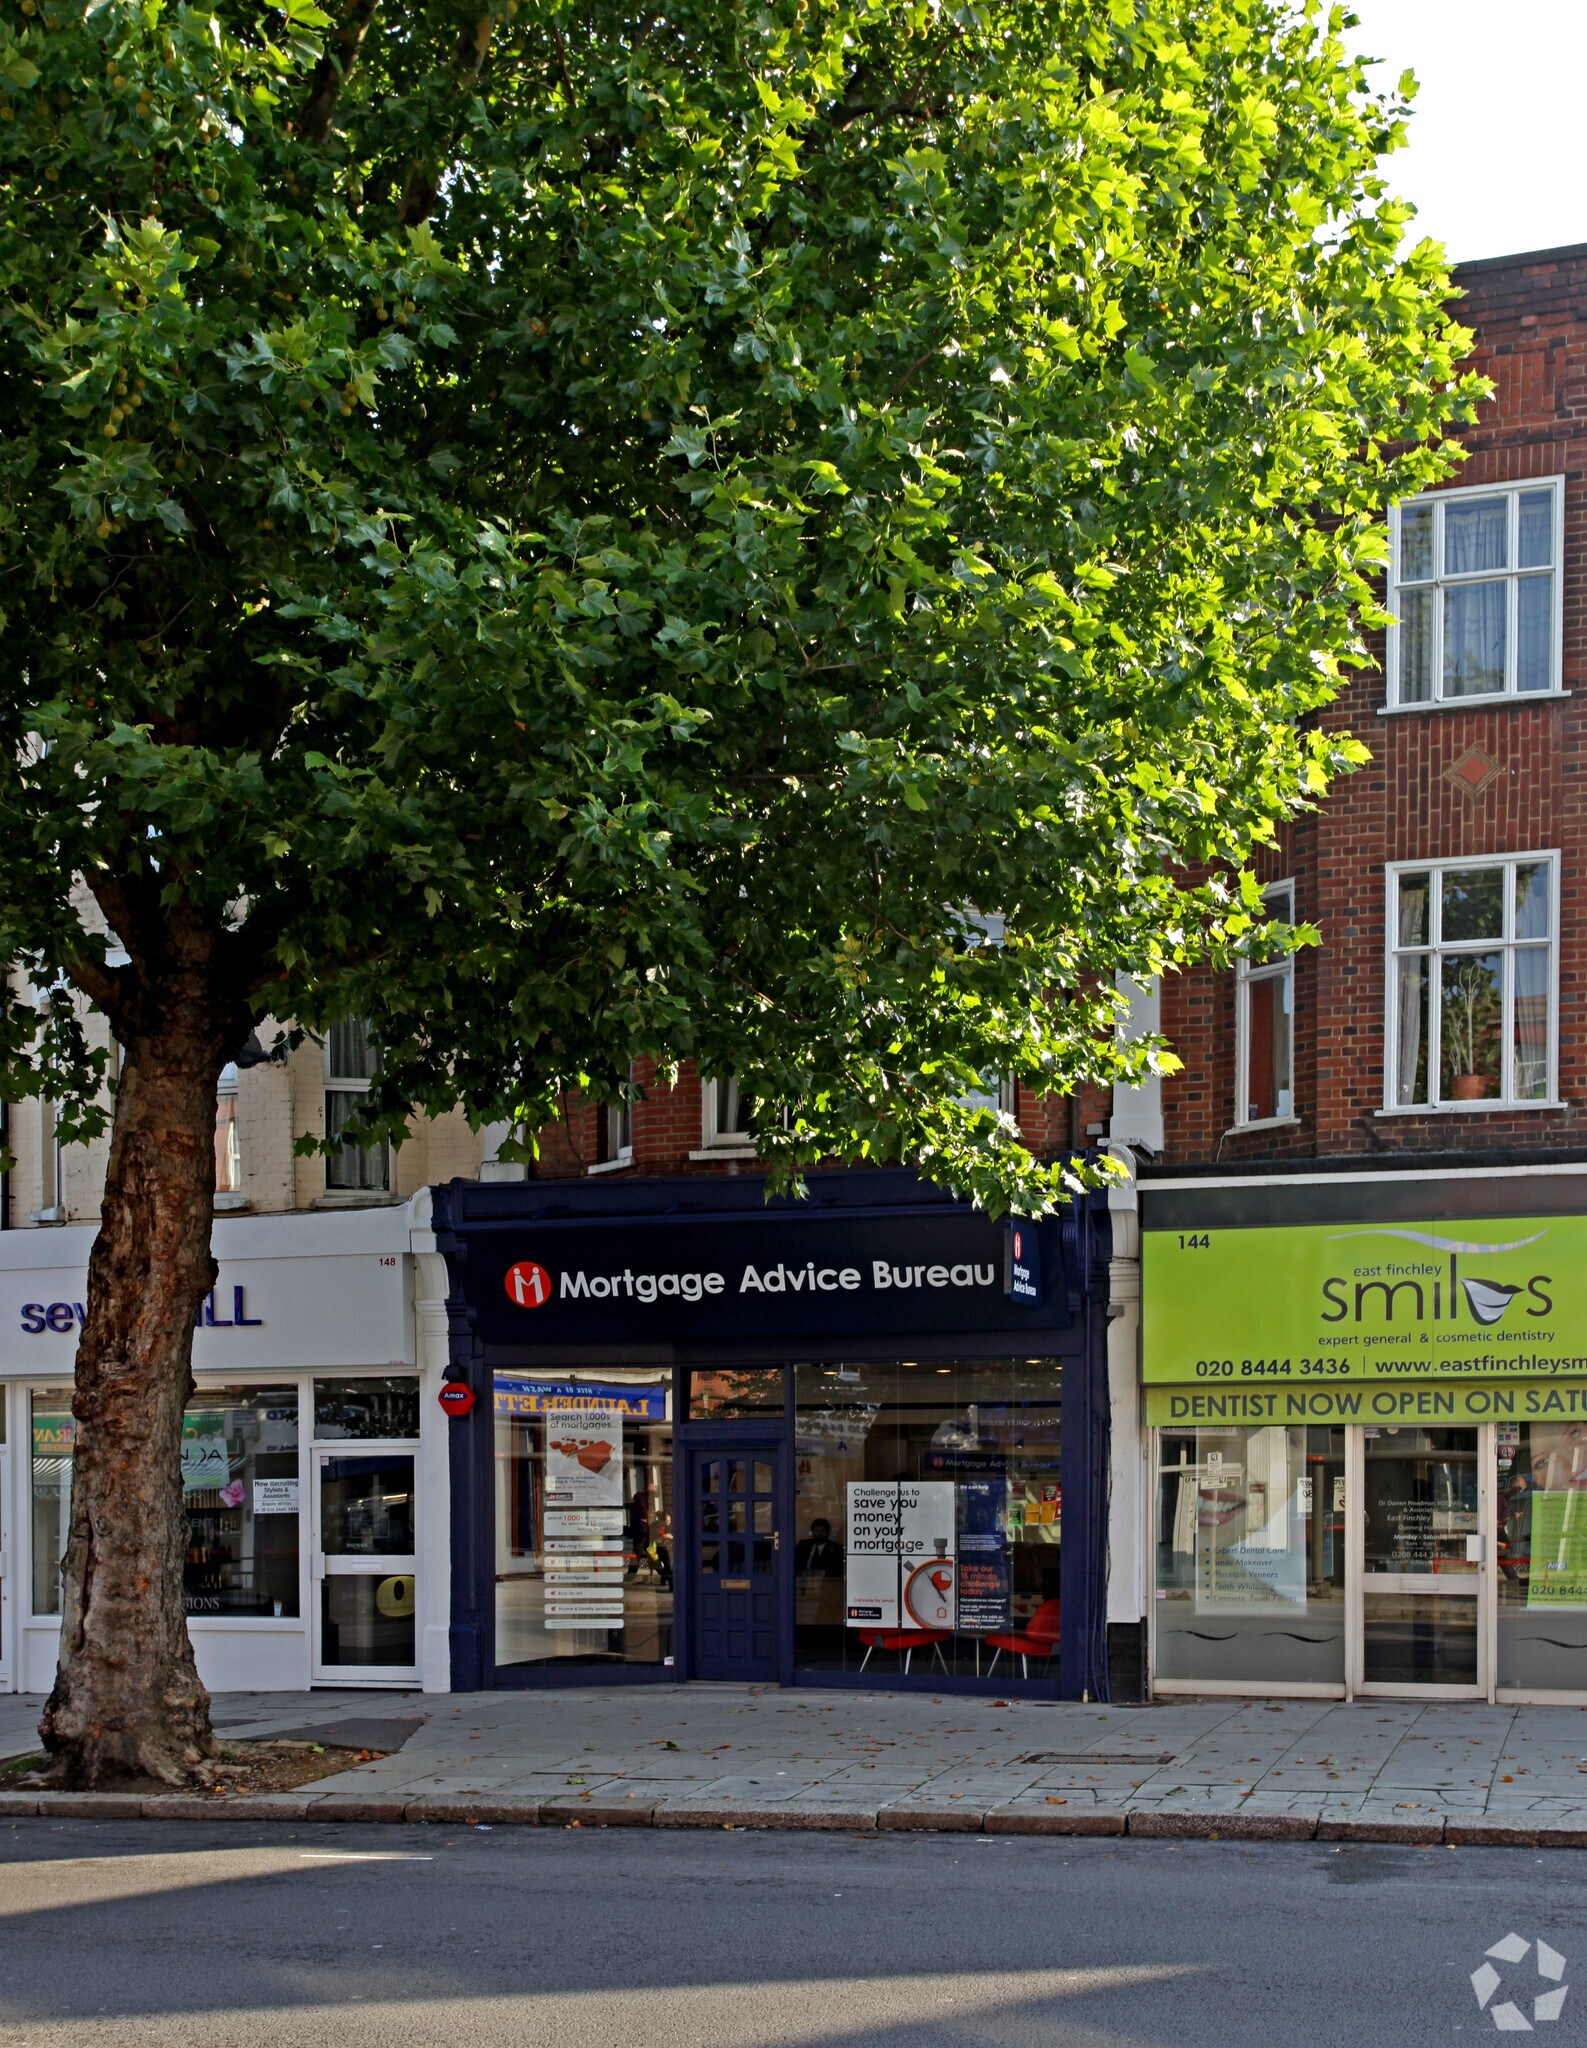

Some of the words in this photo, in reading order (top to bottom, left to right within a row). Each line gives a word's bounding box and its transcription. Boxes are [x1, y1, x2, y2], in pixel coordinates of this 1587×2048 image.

[1178, 1235, 1210, 1250] 144
[379, 1258, 396, 1267] 148
[1354, 1266, 1381, 1277] east
[1386, 1263, 1442, 1277] finchley
[560, 1269, 725, 1303] Mortgage
[739, 1262, 861, 1293] Advice
[872, 1261, 995, 1289] Bureau
[1318, 1335, 1359, 1347] expert
[1363, 1333, 1412, 1347] general
[1420, 1334, 1429, 1343] &
[1436, 1331, 1492, 1343] cosmetic
[1496, 1330, 1555, 1342] dentistry
[1196, 1361, 1233, 1376] 020
[1240, 1360, 1291, 1376] 8444
[1299, 1358, 1350, 1375] 3436
[1170, 1393, 1277, 1418] DENTIST
[1286, 1392, 1363, 1416] NOW
[1372, 1391, 1455, 1416] OPEN
[1465, 1390, 1515, 1415] ON
[550, 1413, 582, 1421] Search
[550, 1421, 559, 1429] of
[561, 1421, 618, 1430] mortgages...
[946, 1459, 987, 1468] Mortgage
[853, 1488, 896, 1497] Challenge
[854, 1499, 885, 1509] save
[890, 1499, 917, 1511] you
[854, 1512, 902, 1525] money
[1403, 1514, 1431, 1522] Finchley
[853, 1527, 870, 1536] on
[874, 1526, 905, 1538] your
[854, 1538, 924, 1552] mortgage
[960, 1581, 1000, 1589] challenge
[1238, 1583, 1275, 1591] Whitening
[960, 1588, 984, 1596] today
[1532, 1586, 1554, 1595] 020
